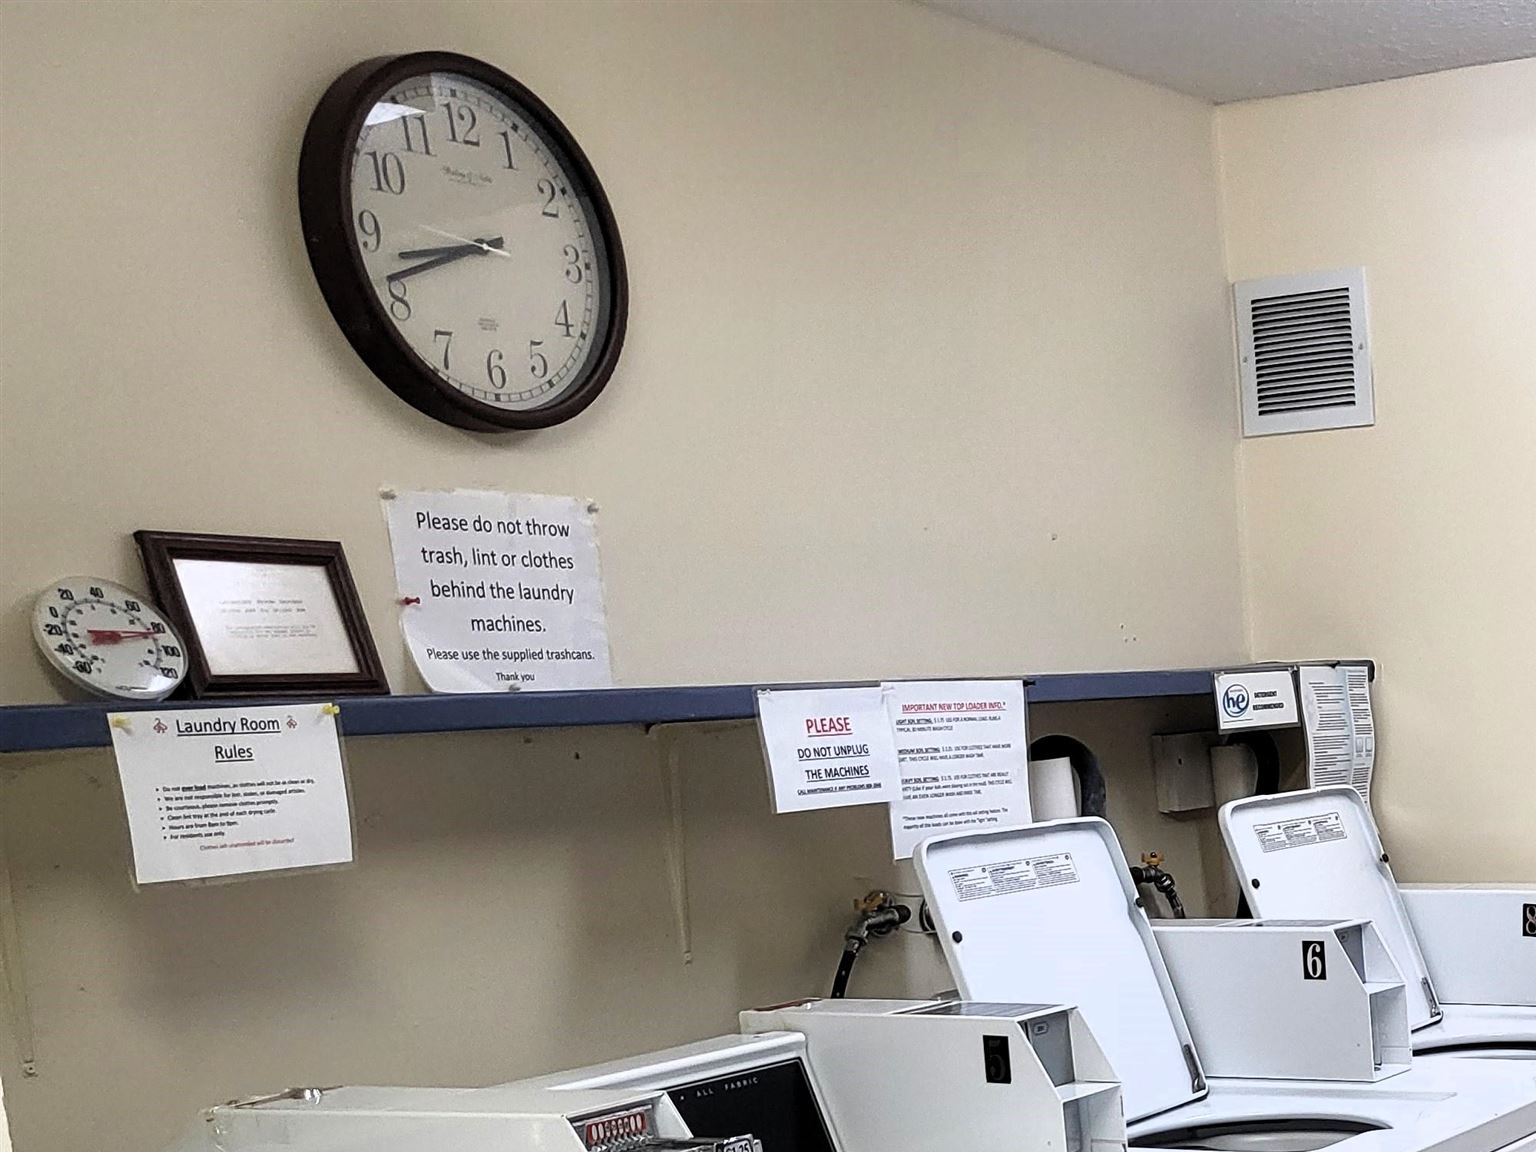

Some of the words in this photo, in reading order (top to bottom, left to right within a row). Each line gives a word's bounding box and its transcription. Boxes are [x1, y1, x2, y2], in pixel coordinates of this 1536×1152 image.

[402, 111, 436, 158] 11
[442, 102, 480, 147] 12
[499, 130, 519, 170] 1
[365, 150, 406, 195] 10
[537, 178, 560, 218] 2
[358, 210, 382, 252] 9
[563, 244, 582, 284] 3
[388, 280, 412, 321] 8
[554, 299, 576, 338] 4
[434, 329, 454, 370] 7
[528, 340, 548, 378] 5
[486, 348, 506, 390] 6
[417, 512, 468, 531] Please
[473, 515, 492, 532] do
[497, 519, 522, 534] not
[526, 518, 570, 537] throw
[421, 547, 468, 568] trash,
[473, 548, 497, 566] lint
[502, 554, 516, 566] or
[522, 550, 574, 569] clothes
[58, 588, 74, 600] 20
[90, 586, 104, 598] 40
[430, 580, 485, 598] behind
[490, 582, 514, 599] the
[519, 583, 574, 604] laundry
[49, 606, 58, 618] 0
[125, 600, 141, 612] 60
[471, 615, 546, 632] machines.
[161, 645, 180, 658] 100
[427, 648, 460, 660] Please
[462, 651, 480, 660] use
[482, 648, 500, 660] the
[502, 648, 544, 662] supplied
[546, 649, 595, 660] trashcans.
[160, 667, 178, 680] 120
[496, 672, 519, 682] Thank
[522, 673, 535, 682] you
[902, 702, 938, 712] IMPORTANT
[938, 702, 952, 711] NEW
[953, 702, 966, 710] TOP
[966, 702, 988, 710] LOADER
[1226, 690, 1246, 710] he
[176, 718, 236, 735] Laundry
[241, 718, 280, 732] Room
[806, 717, 852, 734] PLEASE
[215, 745, 254, 760] Rules
[797, 748, 812, 758] DO
[813, 746, 832, 758] NOT
[833, 744, 870, 756] UNPLUG
[804, 768, 823, 780] THE
[824, 765, 870, 778] MACHINES
[1306, 942, 1322, 978] 6
[696, 1088, 714, 1098] ALL
[724, 1077, 758, 1090] FABRIC
